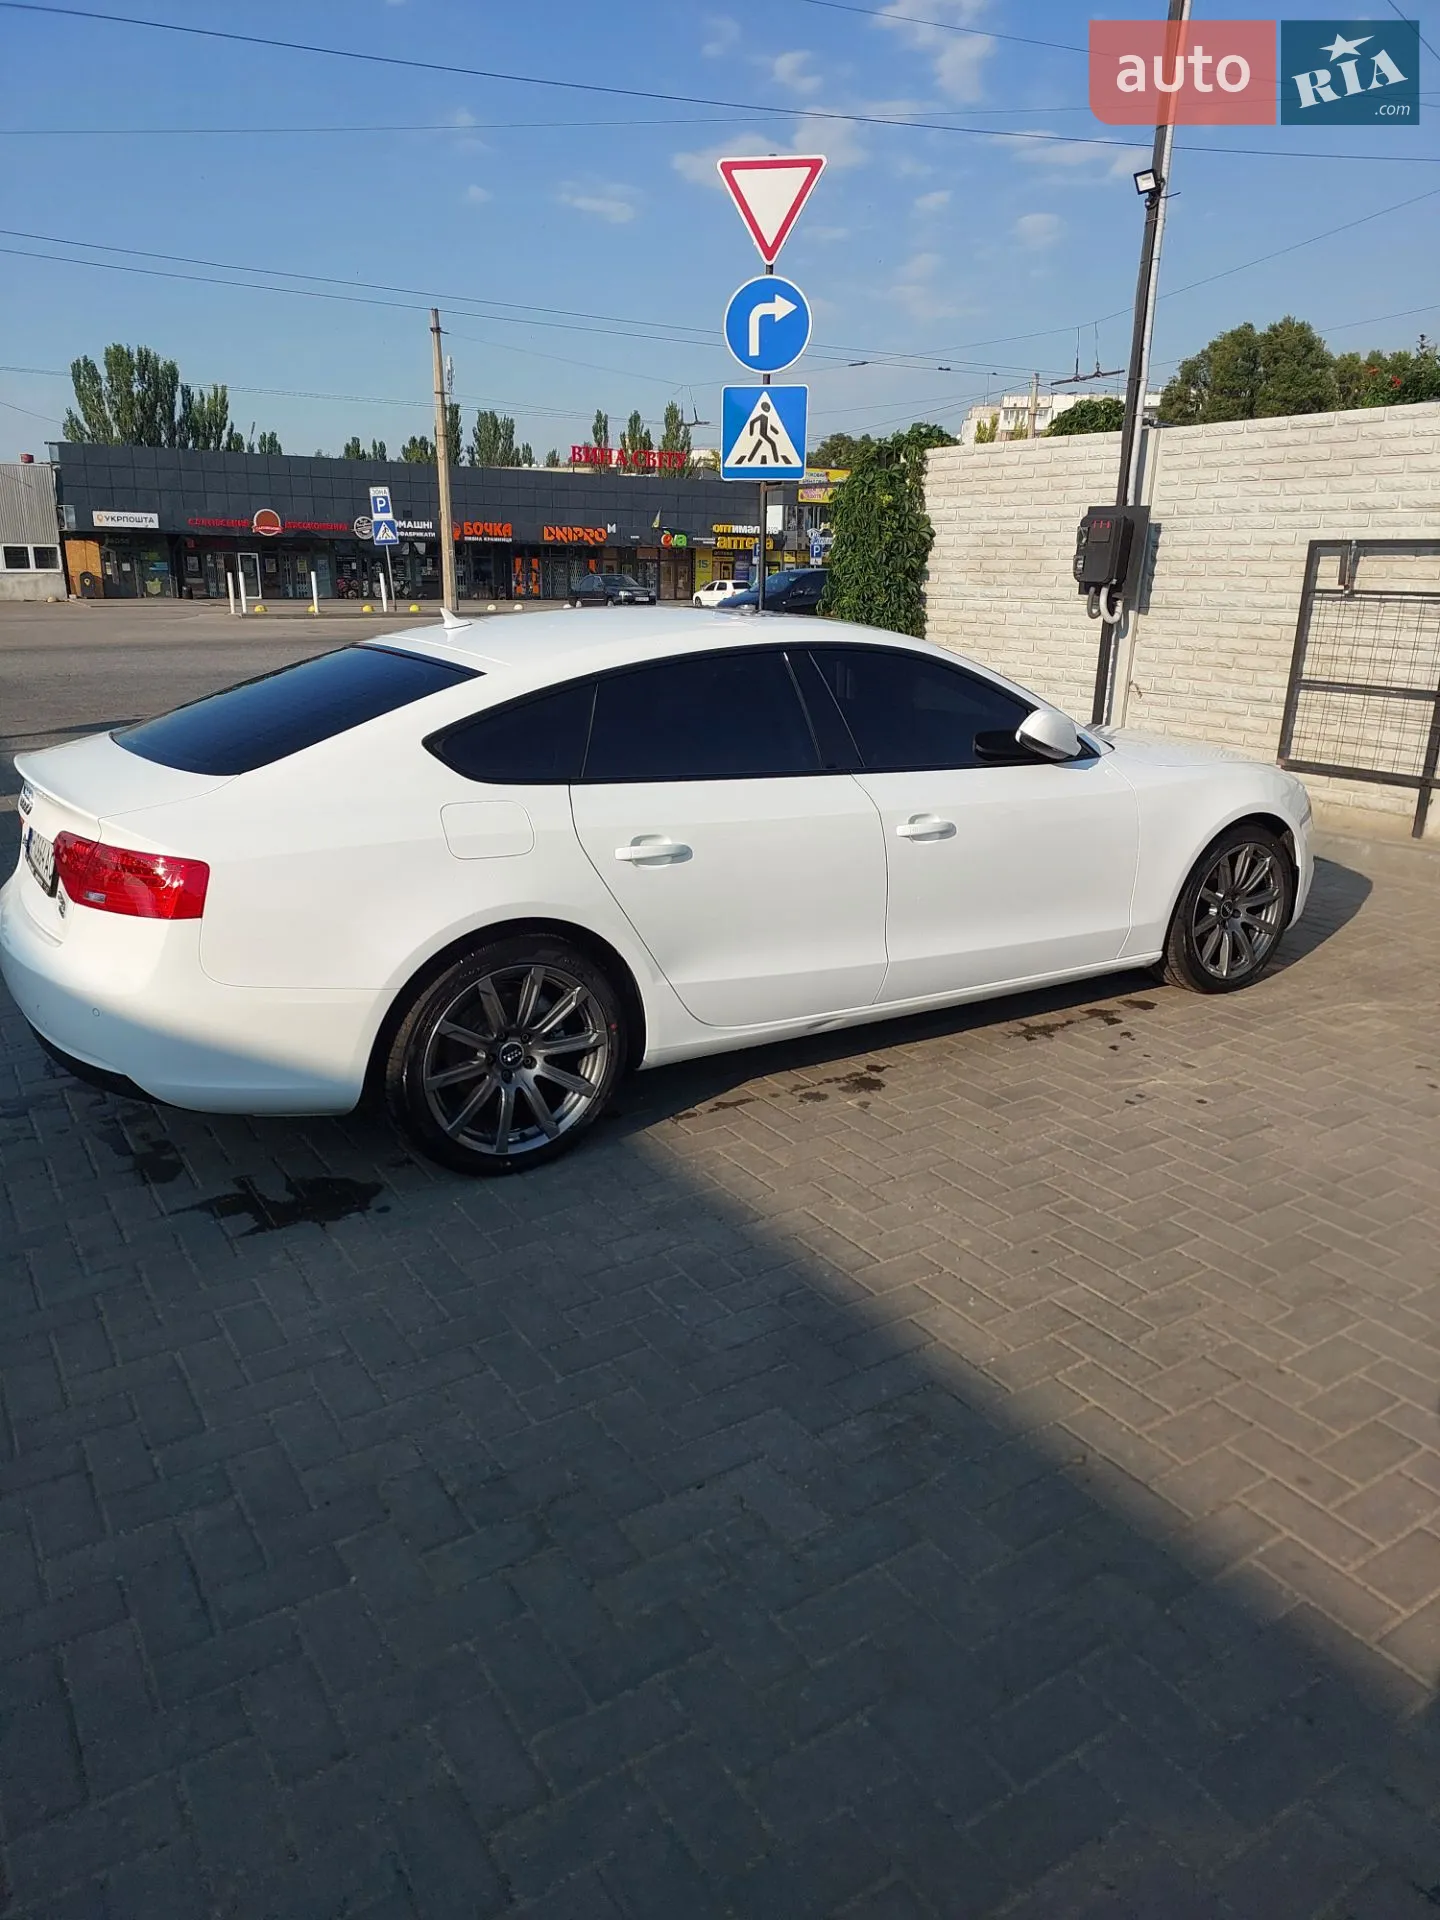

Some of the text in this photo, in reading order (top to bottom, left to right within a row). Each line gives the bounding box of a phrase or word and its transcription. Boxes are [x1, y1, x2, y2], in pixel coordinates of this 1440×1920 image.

[571, 445, 687, 470] ВИНА СВІТУ
[376, 497, 387, 512] P
[104, 515, 155, 524] УКРПОШТА
[396, 520, 433, 530] МАШНІ
[463, 521, 513, 537] БОЧКА
[543, 523, 617, 546] DNIPRO M
[712, 524, 780, 534] оптимална
[717, 536, 774, 549] аптеа
[813, 545, 821, 557] P
